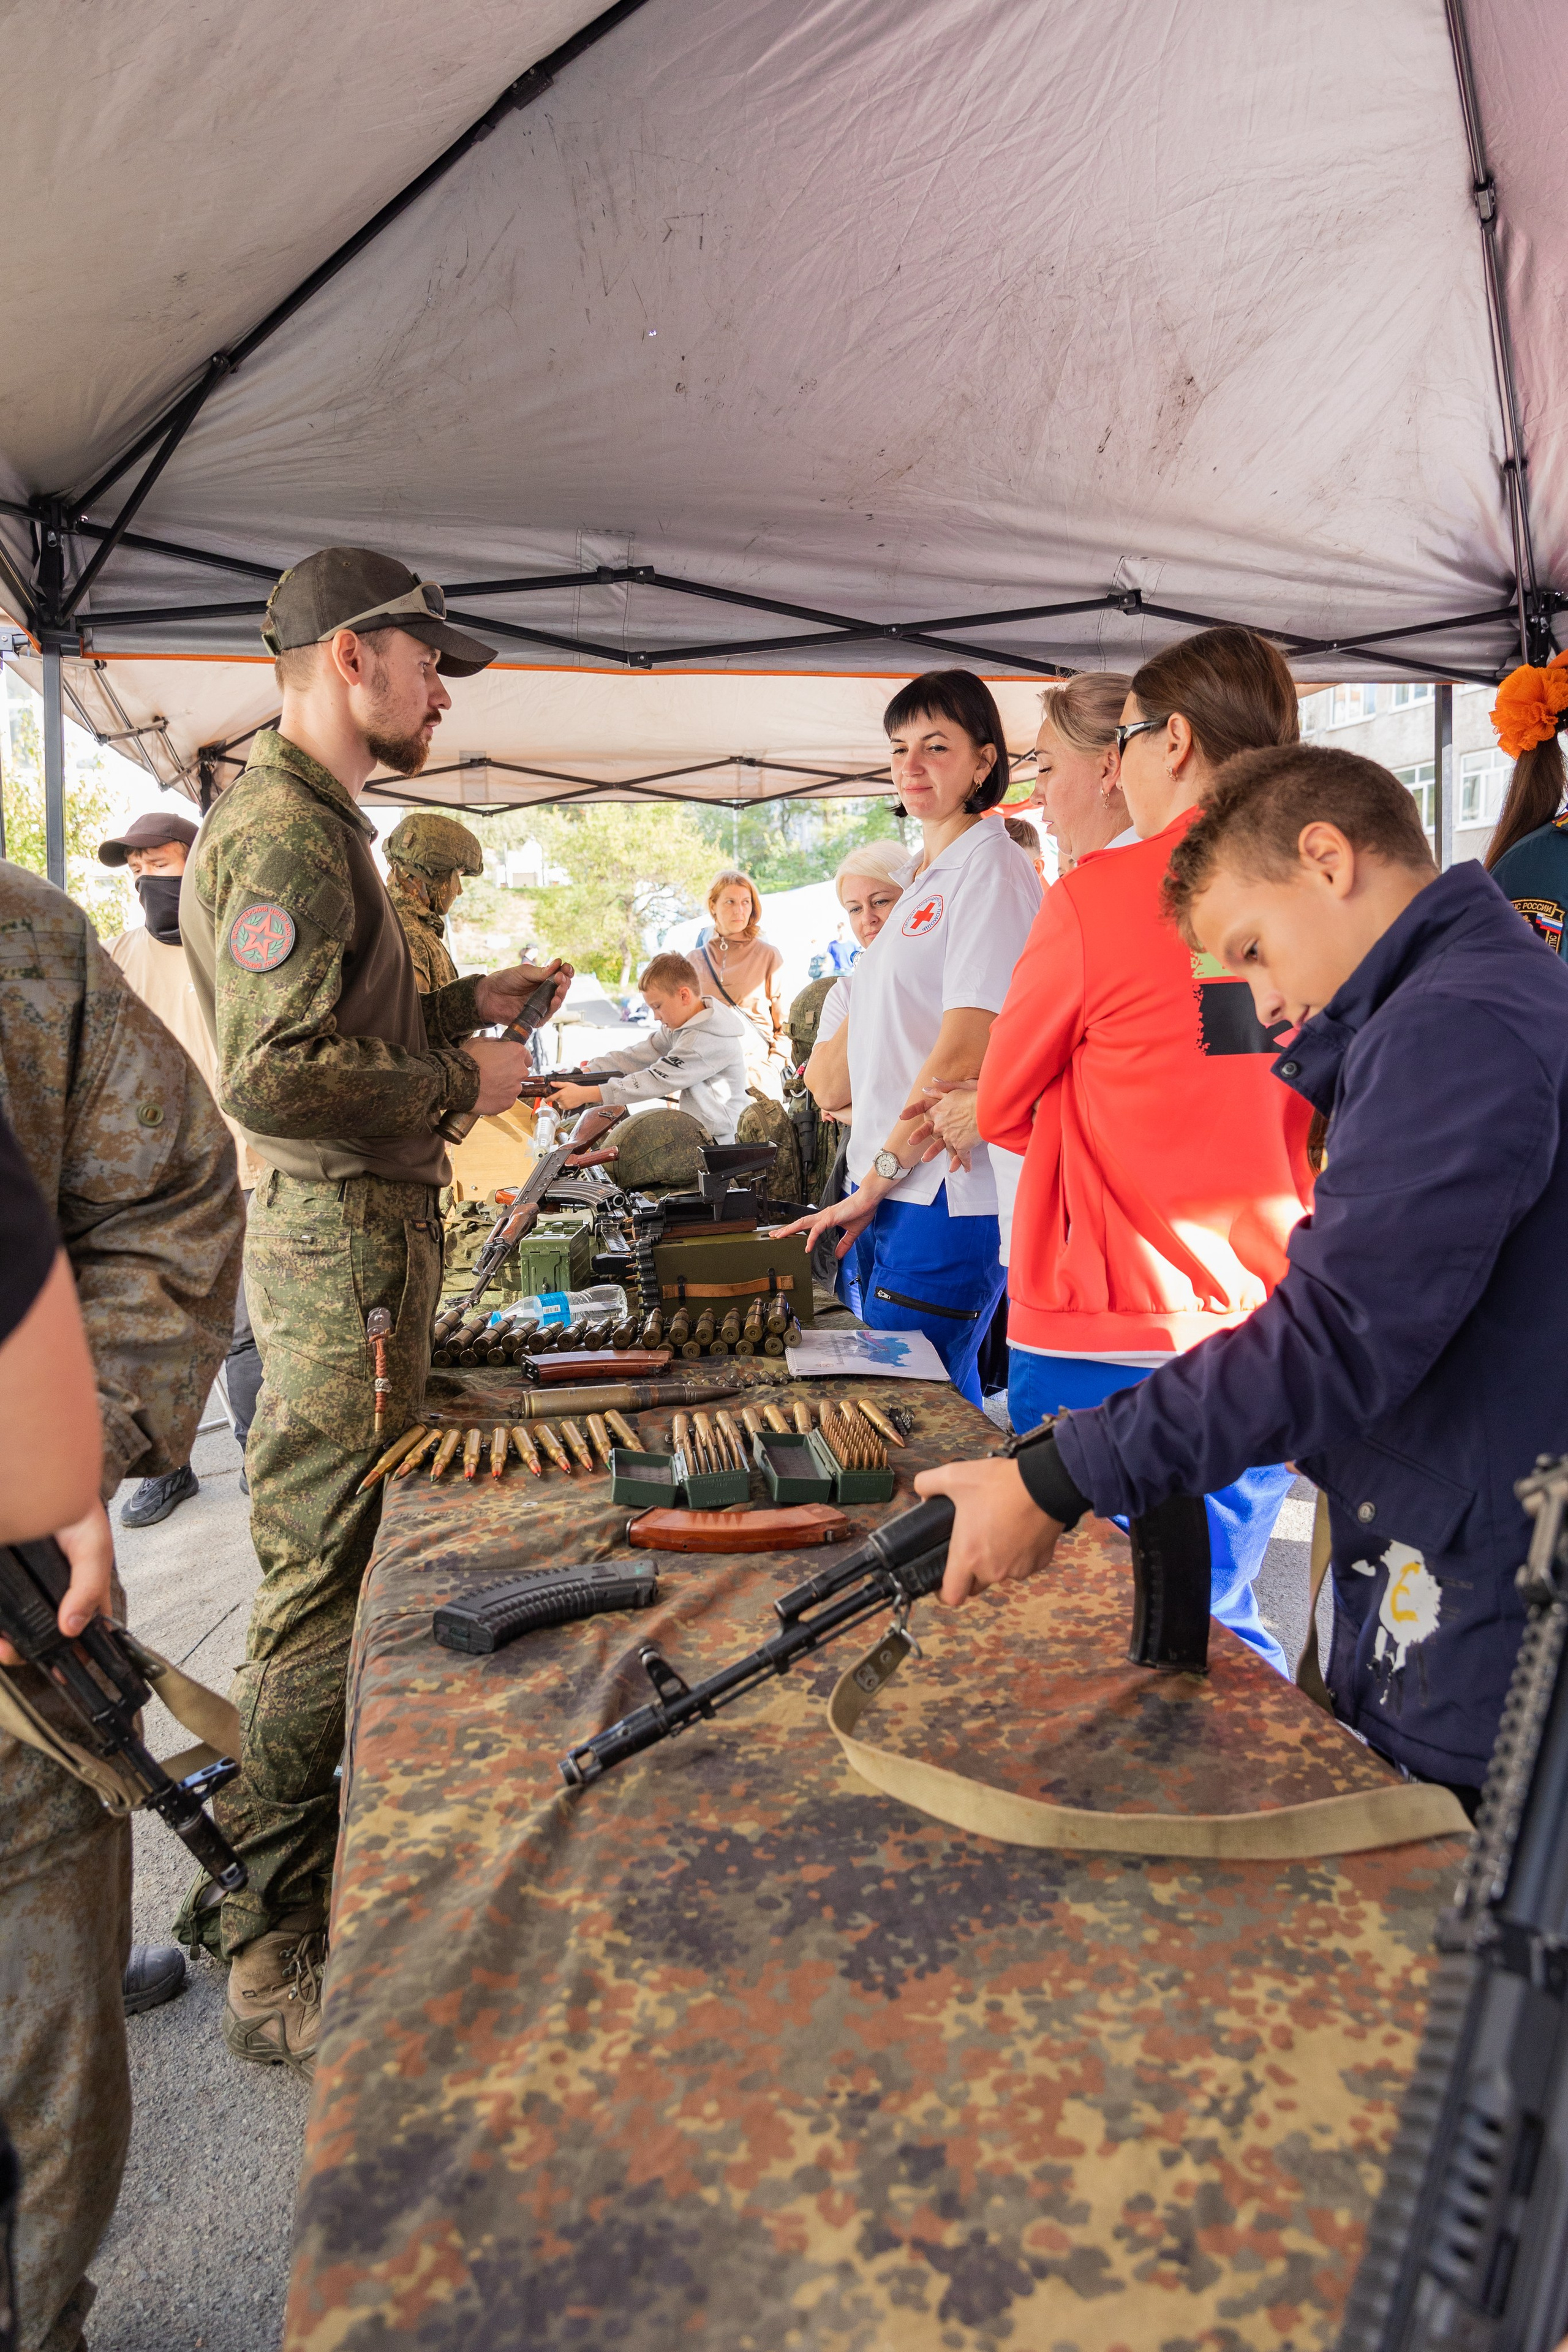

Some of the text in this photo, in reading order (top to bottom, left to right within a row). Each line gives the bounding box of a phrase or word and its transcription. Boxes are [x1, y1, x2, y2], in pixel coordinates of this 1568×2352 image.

[1523, 902, 1552, 913] РОССИИ
[270, 908, 287, 921] ЦЕНТР
[232, 944, 262, 969] ПРИМОРСКИЙ
